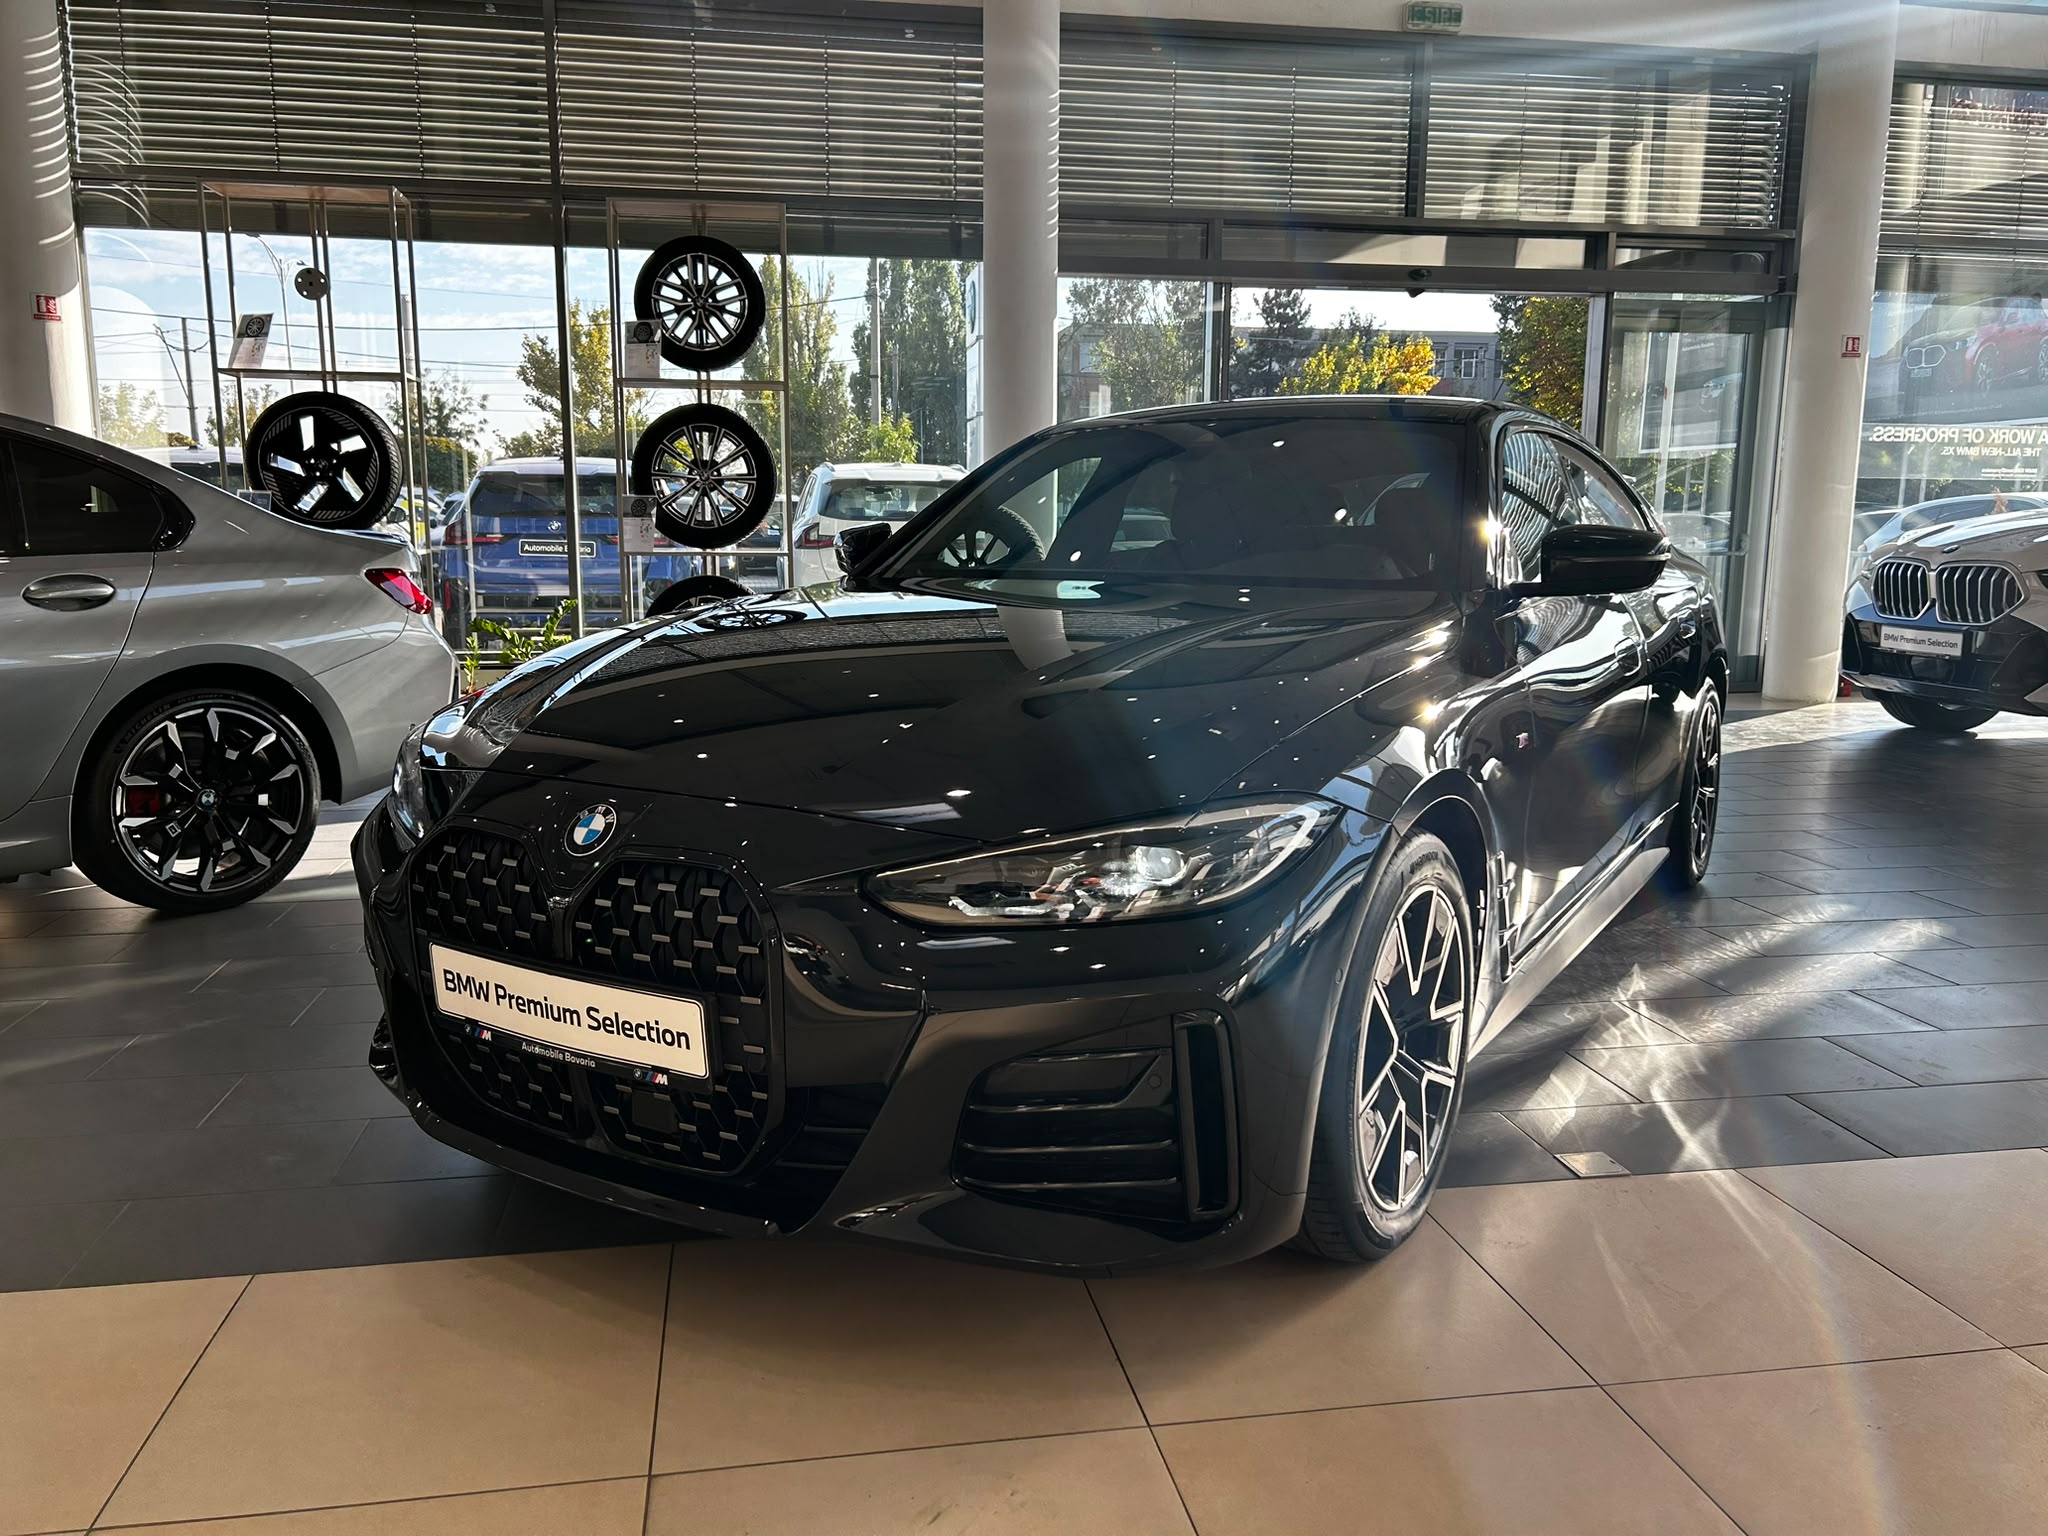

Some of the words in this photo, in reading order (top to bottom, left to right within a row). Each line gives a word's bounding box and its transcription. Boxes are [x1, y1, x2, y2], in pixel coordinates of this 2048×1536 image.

[523, 544, 563, 553] Automobile
[1883, 633, 1898, 642] BMW
[1900, 635, 1926, 645] Premium
[1927, 638, 1958, 648] Selection
[580, 806, 614, 823] BMW
[443, 968, 489, 1003] BMW
[494, 983, 582, 1028] Premium
[585, 1006, 691, 1050] Selection
[521, 1041, 564, 1061] Automobile
[565, 1052, 596, 1068] Bavaria
